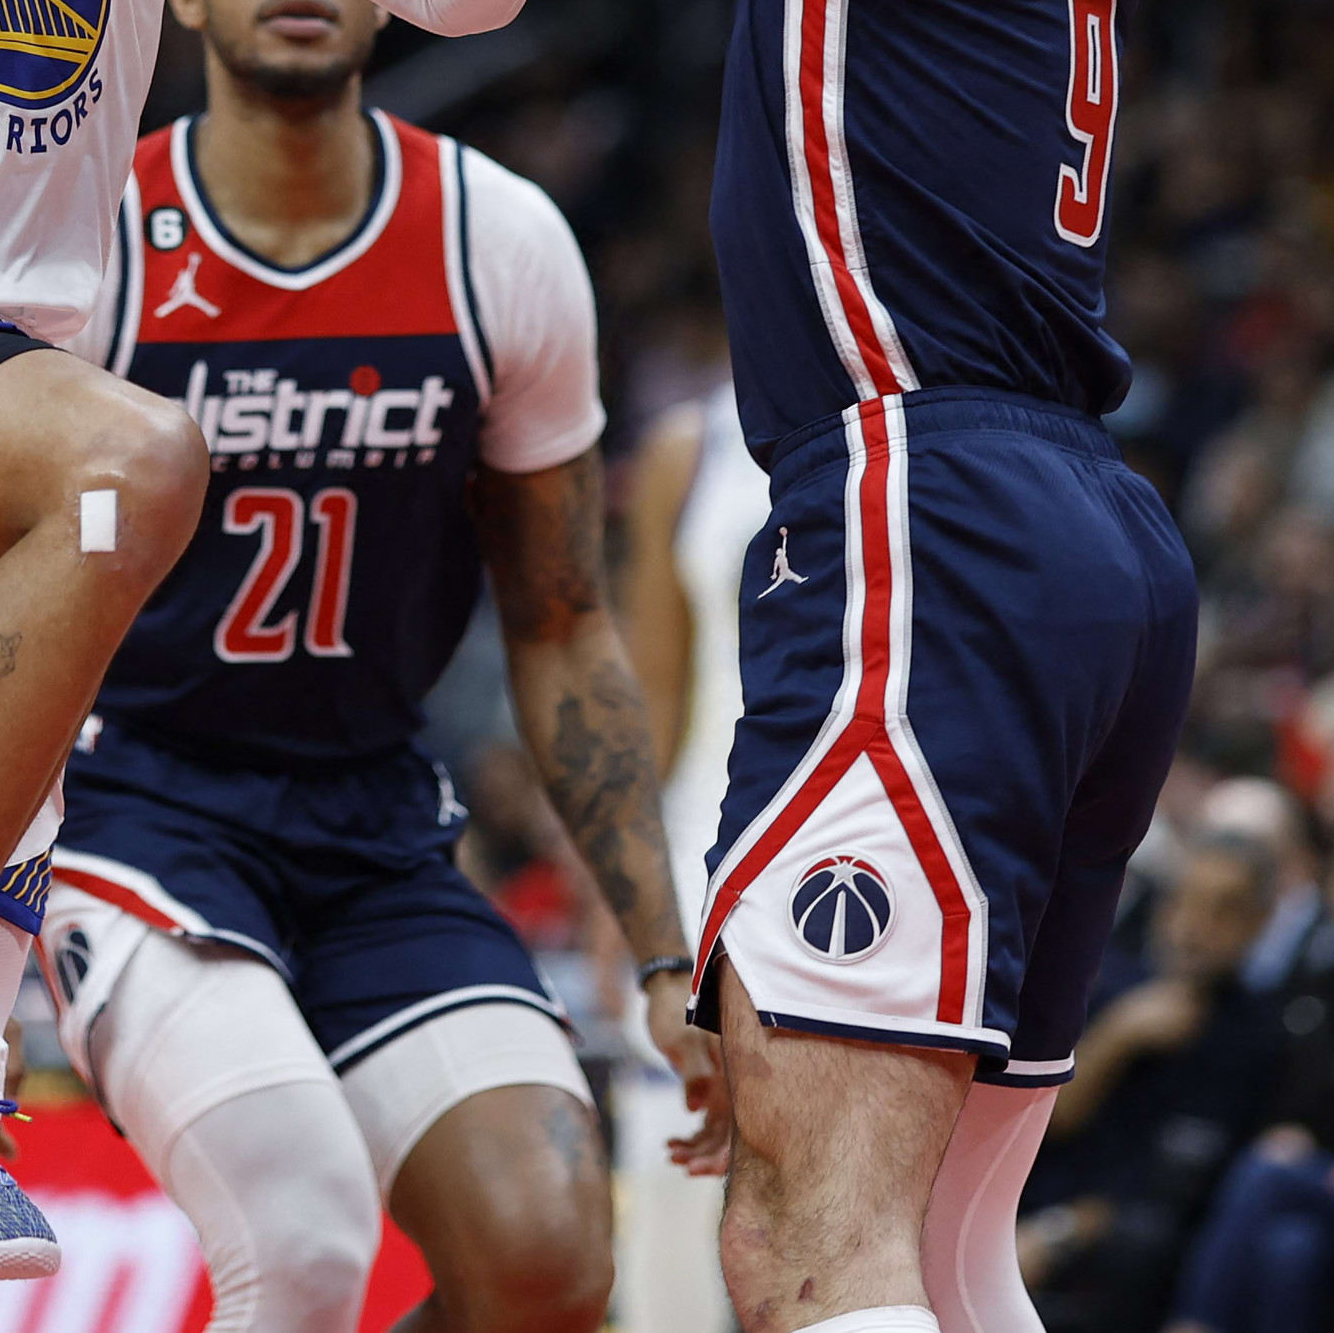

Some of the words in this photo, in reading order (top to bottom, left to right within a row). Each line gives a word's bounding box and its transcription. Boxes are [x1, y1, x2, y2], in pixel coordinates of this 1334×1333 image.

[151, 209, 183, 249] 6
[222, 368, 278, 395] THE
[214, 486, 358, 663] 21
